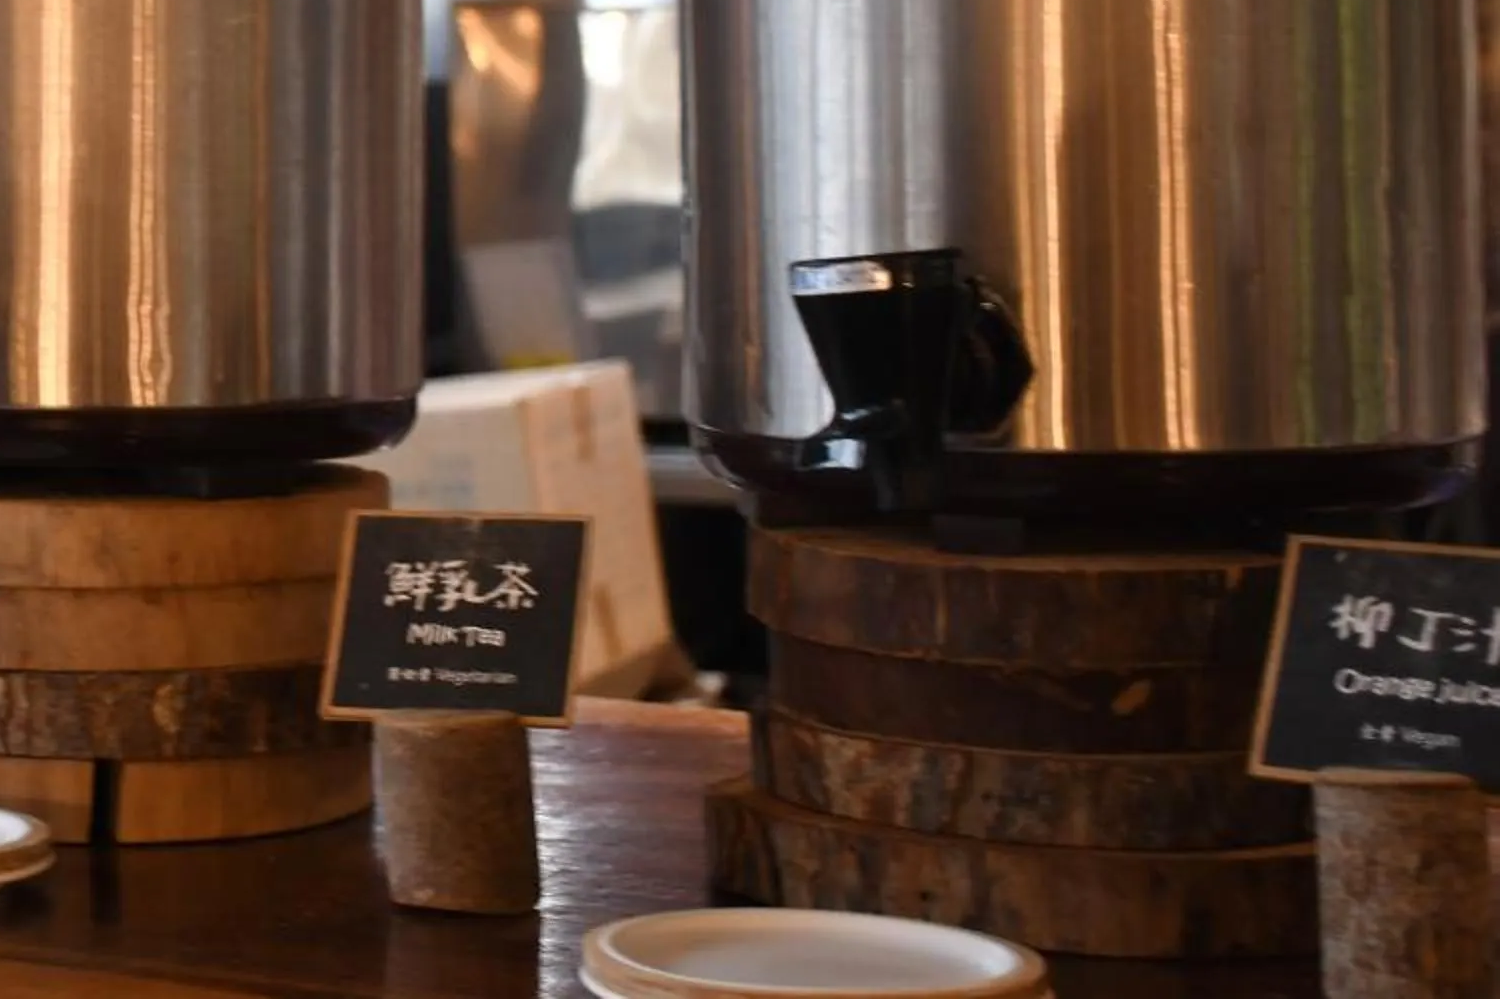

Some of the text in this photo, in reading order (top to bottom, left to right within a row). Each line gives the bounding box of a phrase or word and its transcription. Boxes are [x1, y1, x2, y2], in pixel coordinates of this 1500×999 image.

[383, 559, 539, 612] 鮮乳茶
[461, 625, 506, 647] Tea
